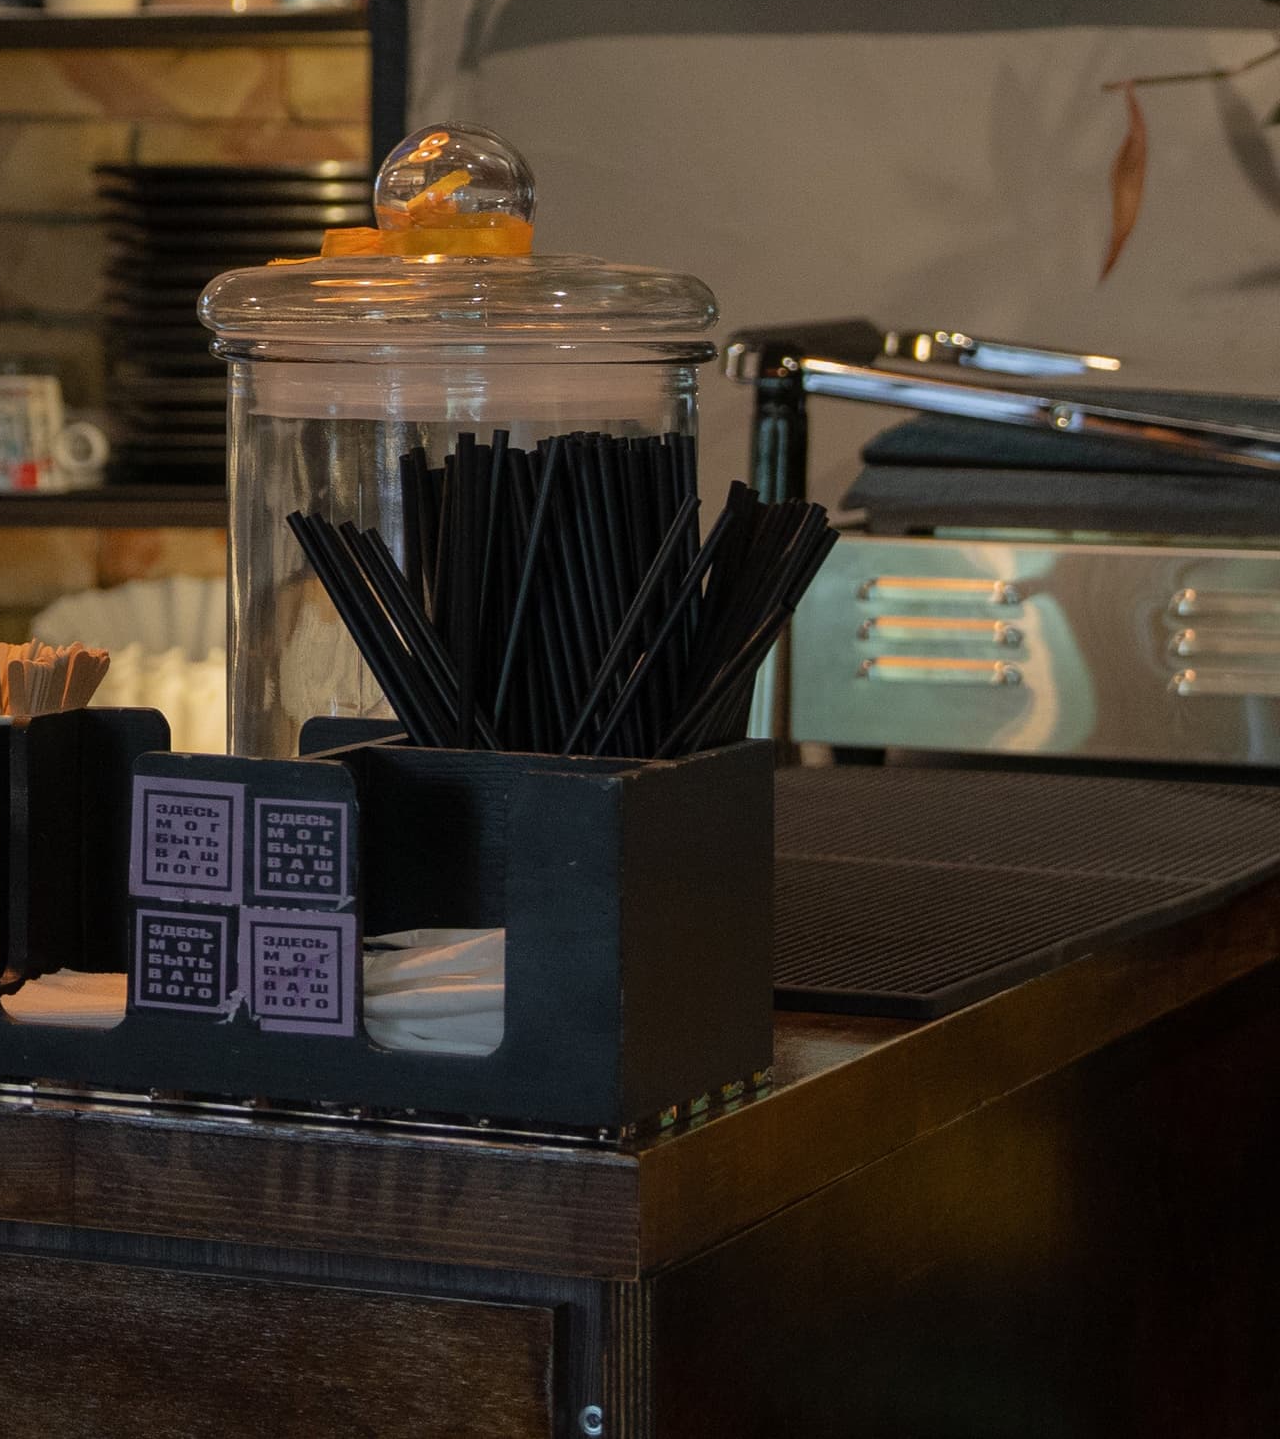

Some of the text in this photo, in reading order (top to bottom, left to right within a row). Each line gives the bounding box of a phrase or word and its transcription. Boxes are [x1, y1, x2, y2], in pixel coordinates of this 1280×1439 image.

[156, 803, 220, 818] ЗДЕСЬ
[268, 813, 333, 827] ЗДЕСЬ
[156, 833, 218, 847] БЫТЬ
[268, 842, 333, 856] БЫТЬ
[156, 863, 218, 877] ЛОГО
[268, 872, 333, 887] ЛОГО
[149, 924, 213, 939] ЗДЕСЬ
[264, 935, 328, 949] ЗДЕСЬ
[149, 953, 212, 969] БЫТЬ
[264, 965, 328, 979] БЫТЬ
[148, 983, 212, 999] ЛОГО
[264, 994, 328, 1009] ЛОГО
